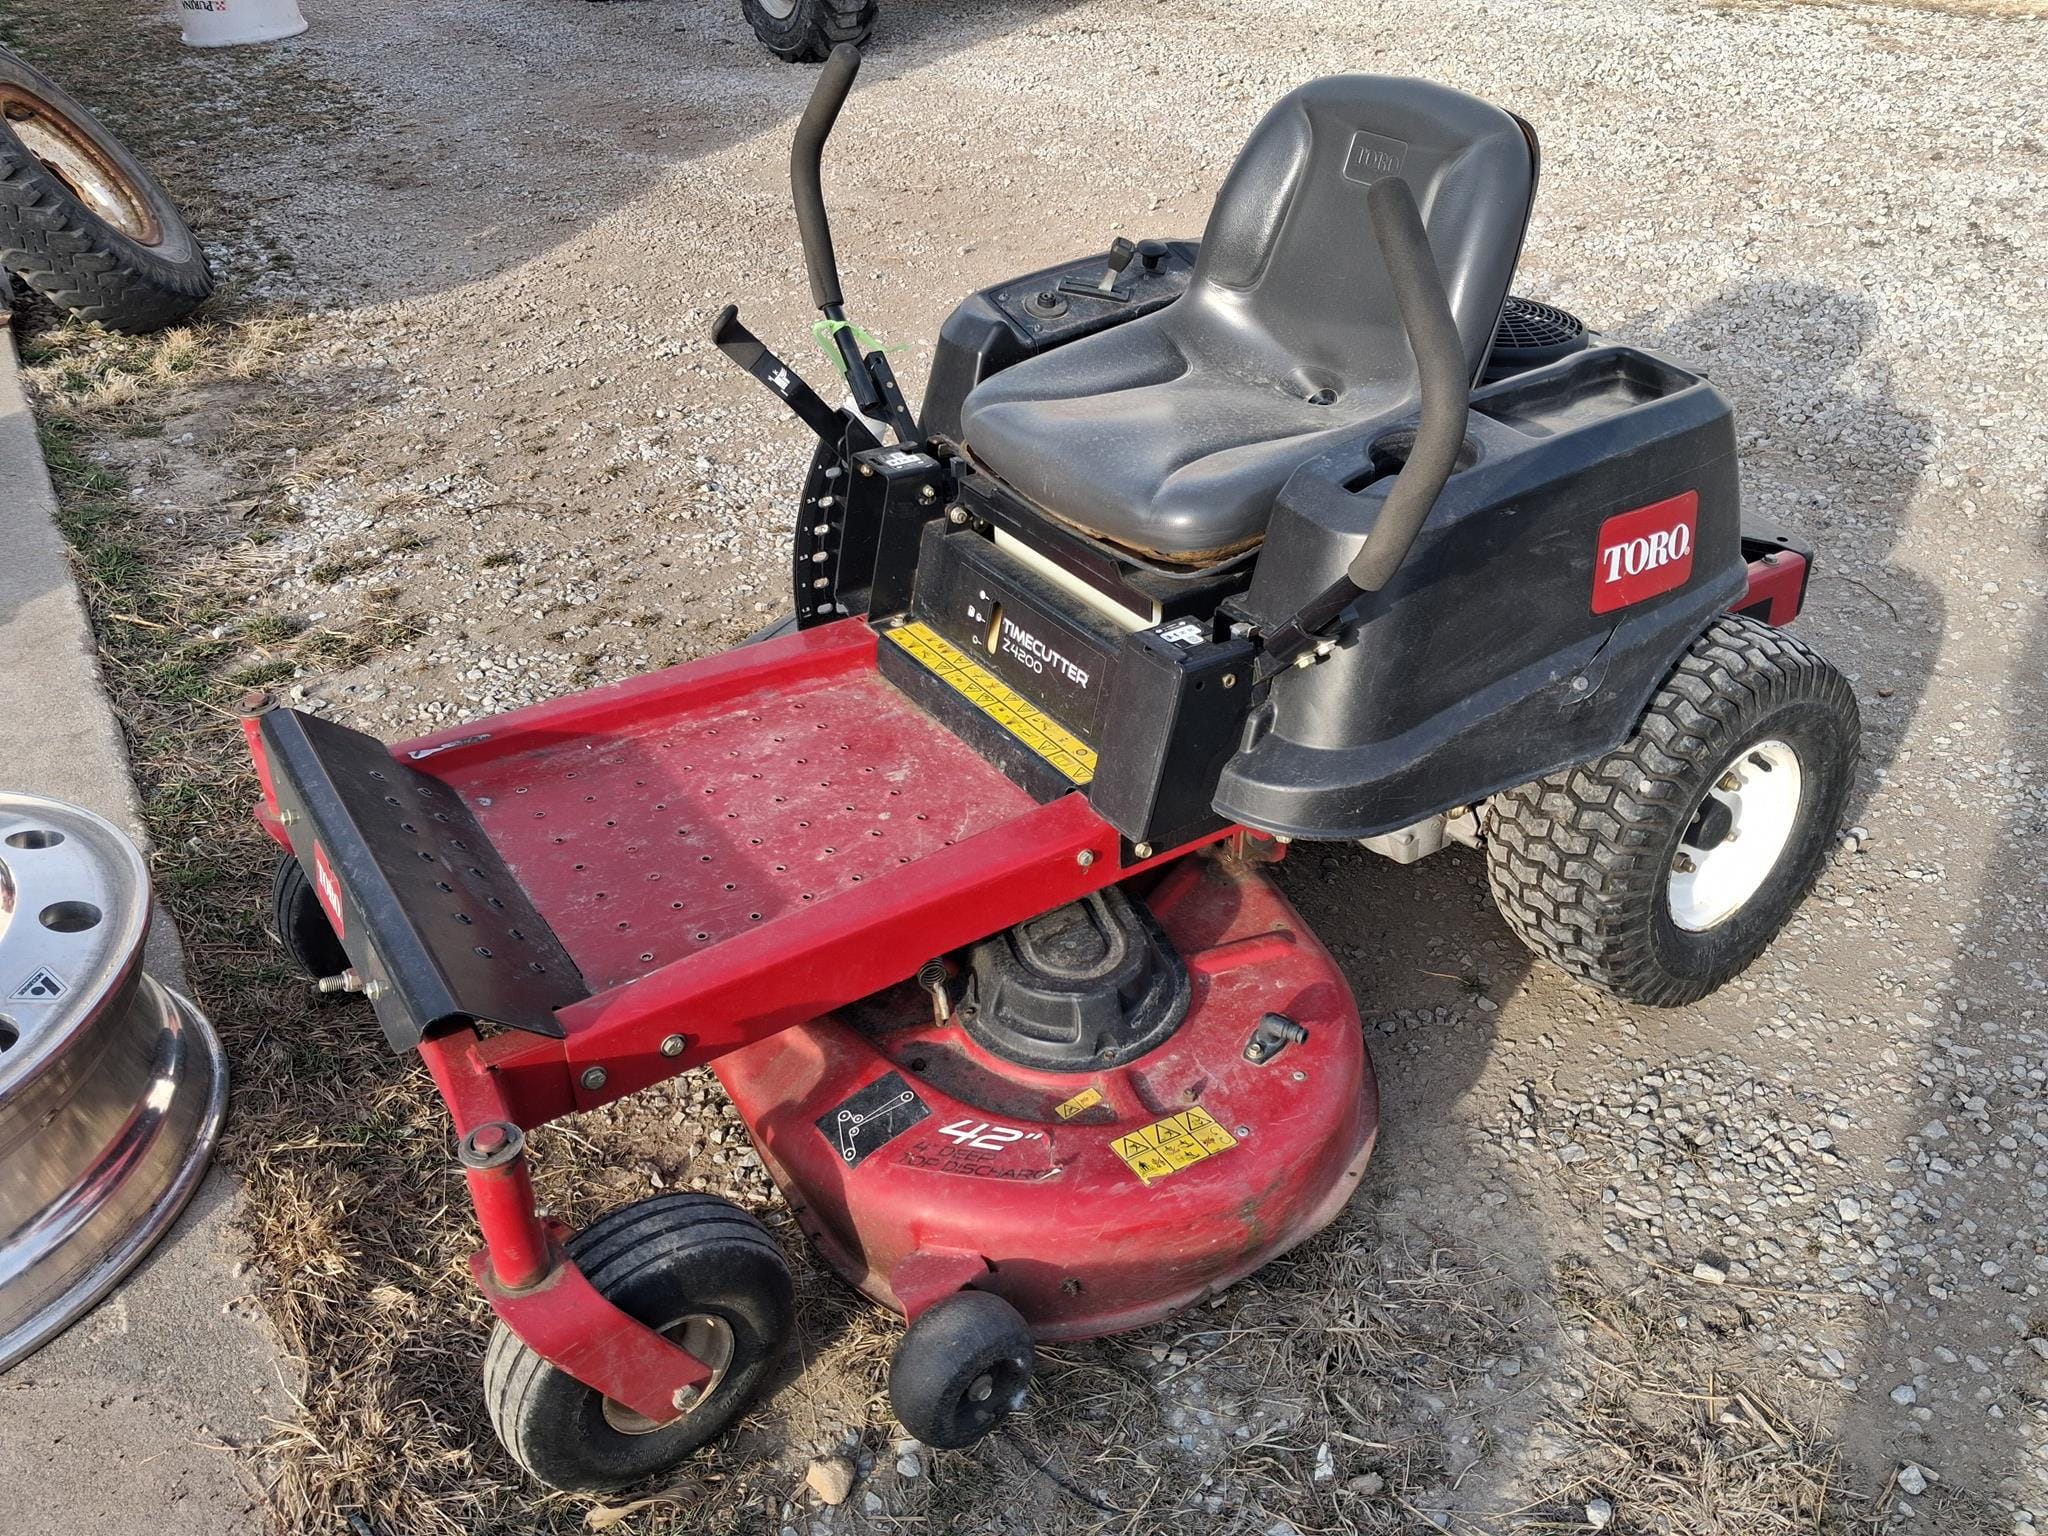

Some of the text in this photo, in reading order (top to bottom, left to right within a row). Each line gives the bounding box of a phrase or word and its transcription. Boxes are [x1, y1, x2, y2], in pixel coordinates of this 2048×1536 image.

[1353, 145, 1400, 173] TORO
[1603, 523, 1690, 583] TORO
[1002, 617, 1089, 689] TIMECUTTER
[1002, 638, 1043, 674] Z4200
